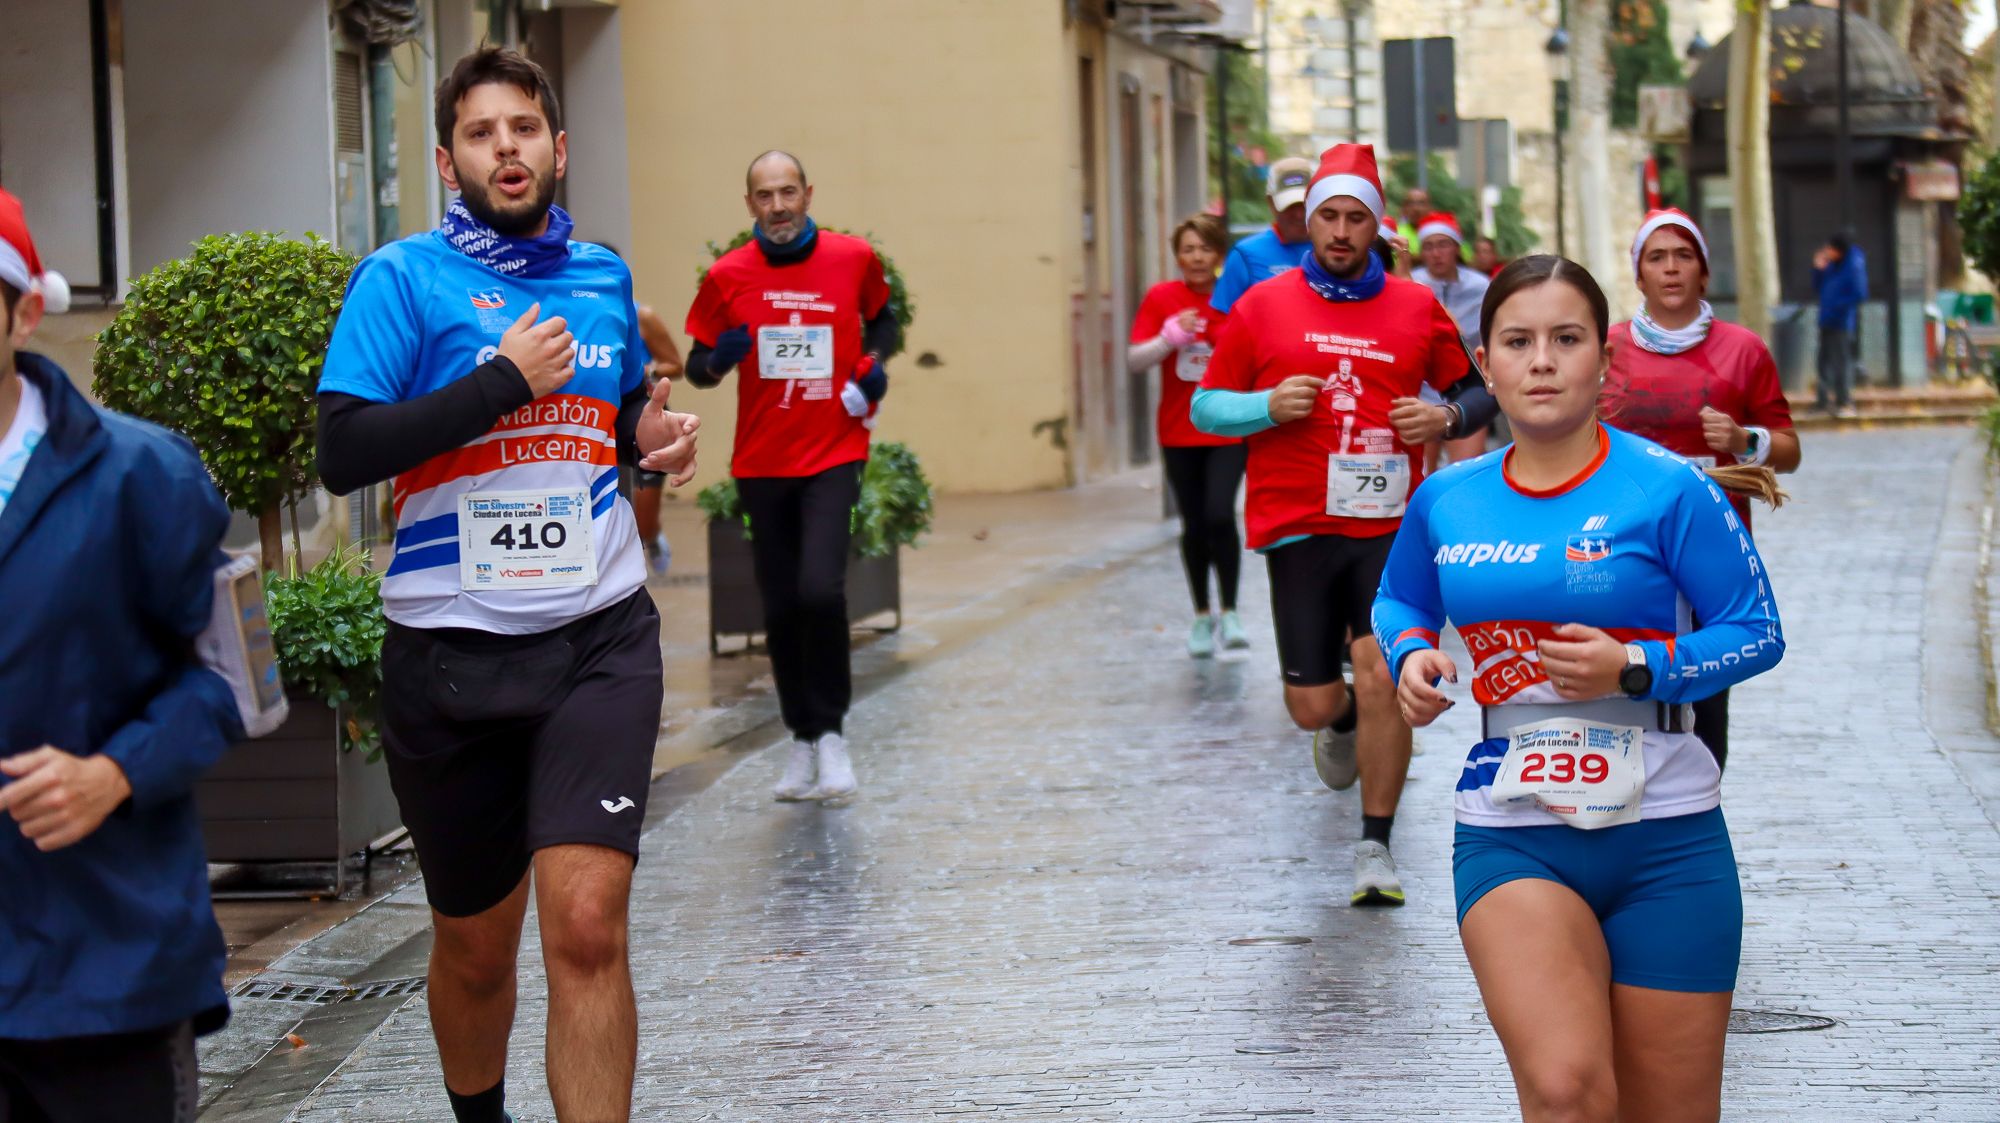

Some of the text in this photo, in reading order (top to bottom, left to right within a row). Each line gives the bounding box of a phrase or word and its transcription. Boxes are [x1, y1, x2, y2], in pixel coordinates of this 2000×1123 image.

[1311, 333, 1329, 343] San
[1330, 334, 1369, 348] Silvestre
[775, 344, 815, 358] 271
[501, 440, 591, 465] Lucena
[1356, 475, 1388, 493] 79
[473, 502, 489, 511] San
[490, 502, 526, 510] Silvestre
[473, 511, 501, 519] Ciudad
[503, 510, 513, 518] de
[514, 510, 542, 518] Lucena
[490, 521, 567, 551] 410
[550, 565, 583, 574] enerplus
[1537, 739, 1546, 747] de
[1547, 738, 1579, 747] Lucena
[1520, 752, 1609, 784] 239
